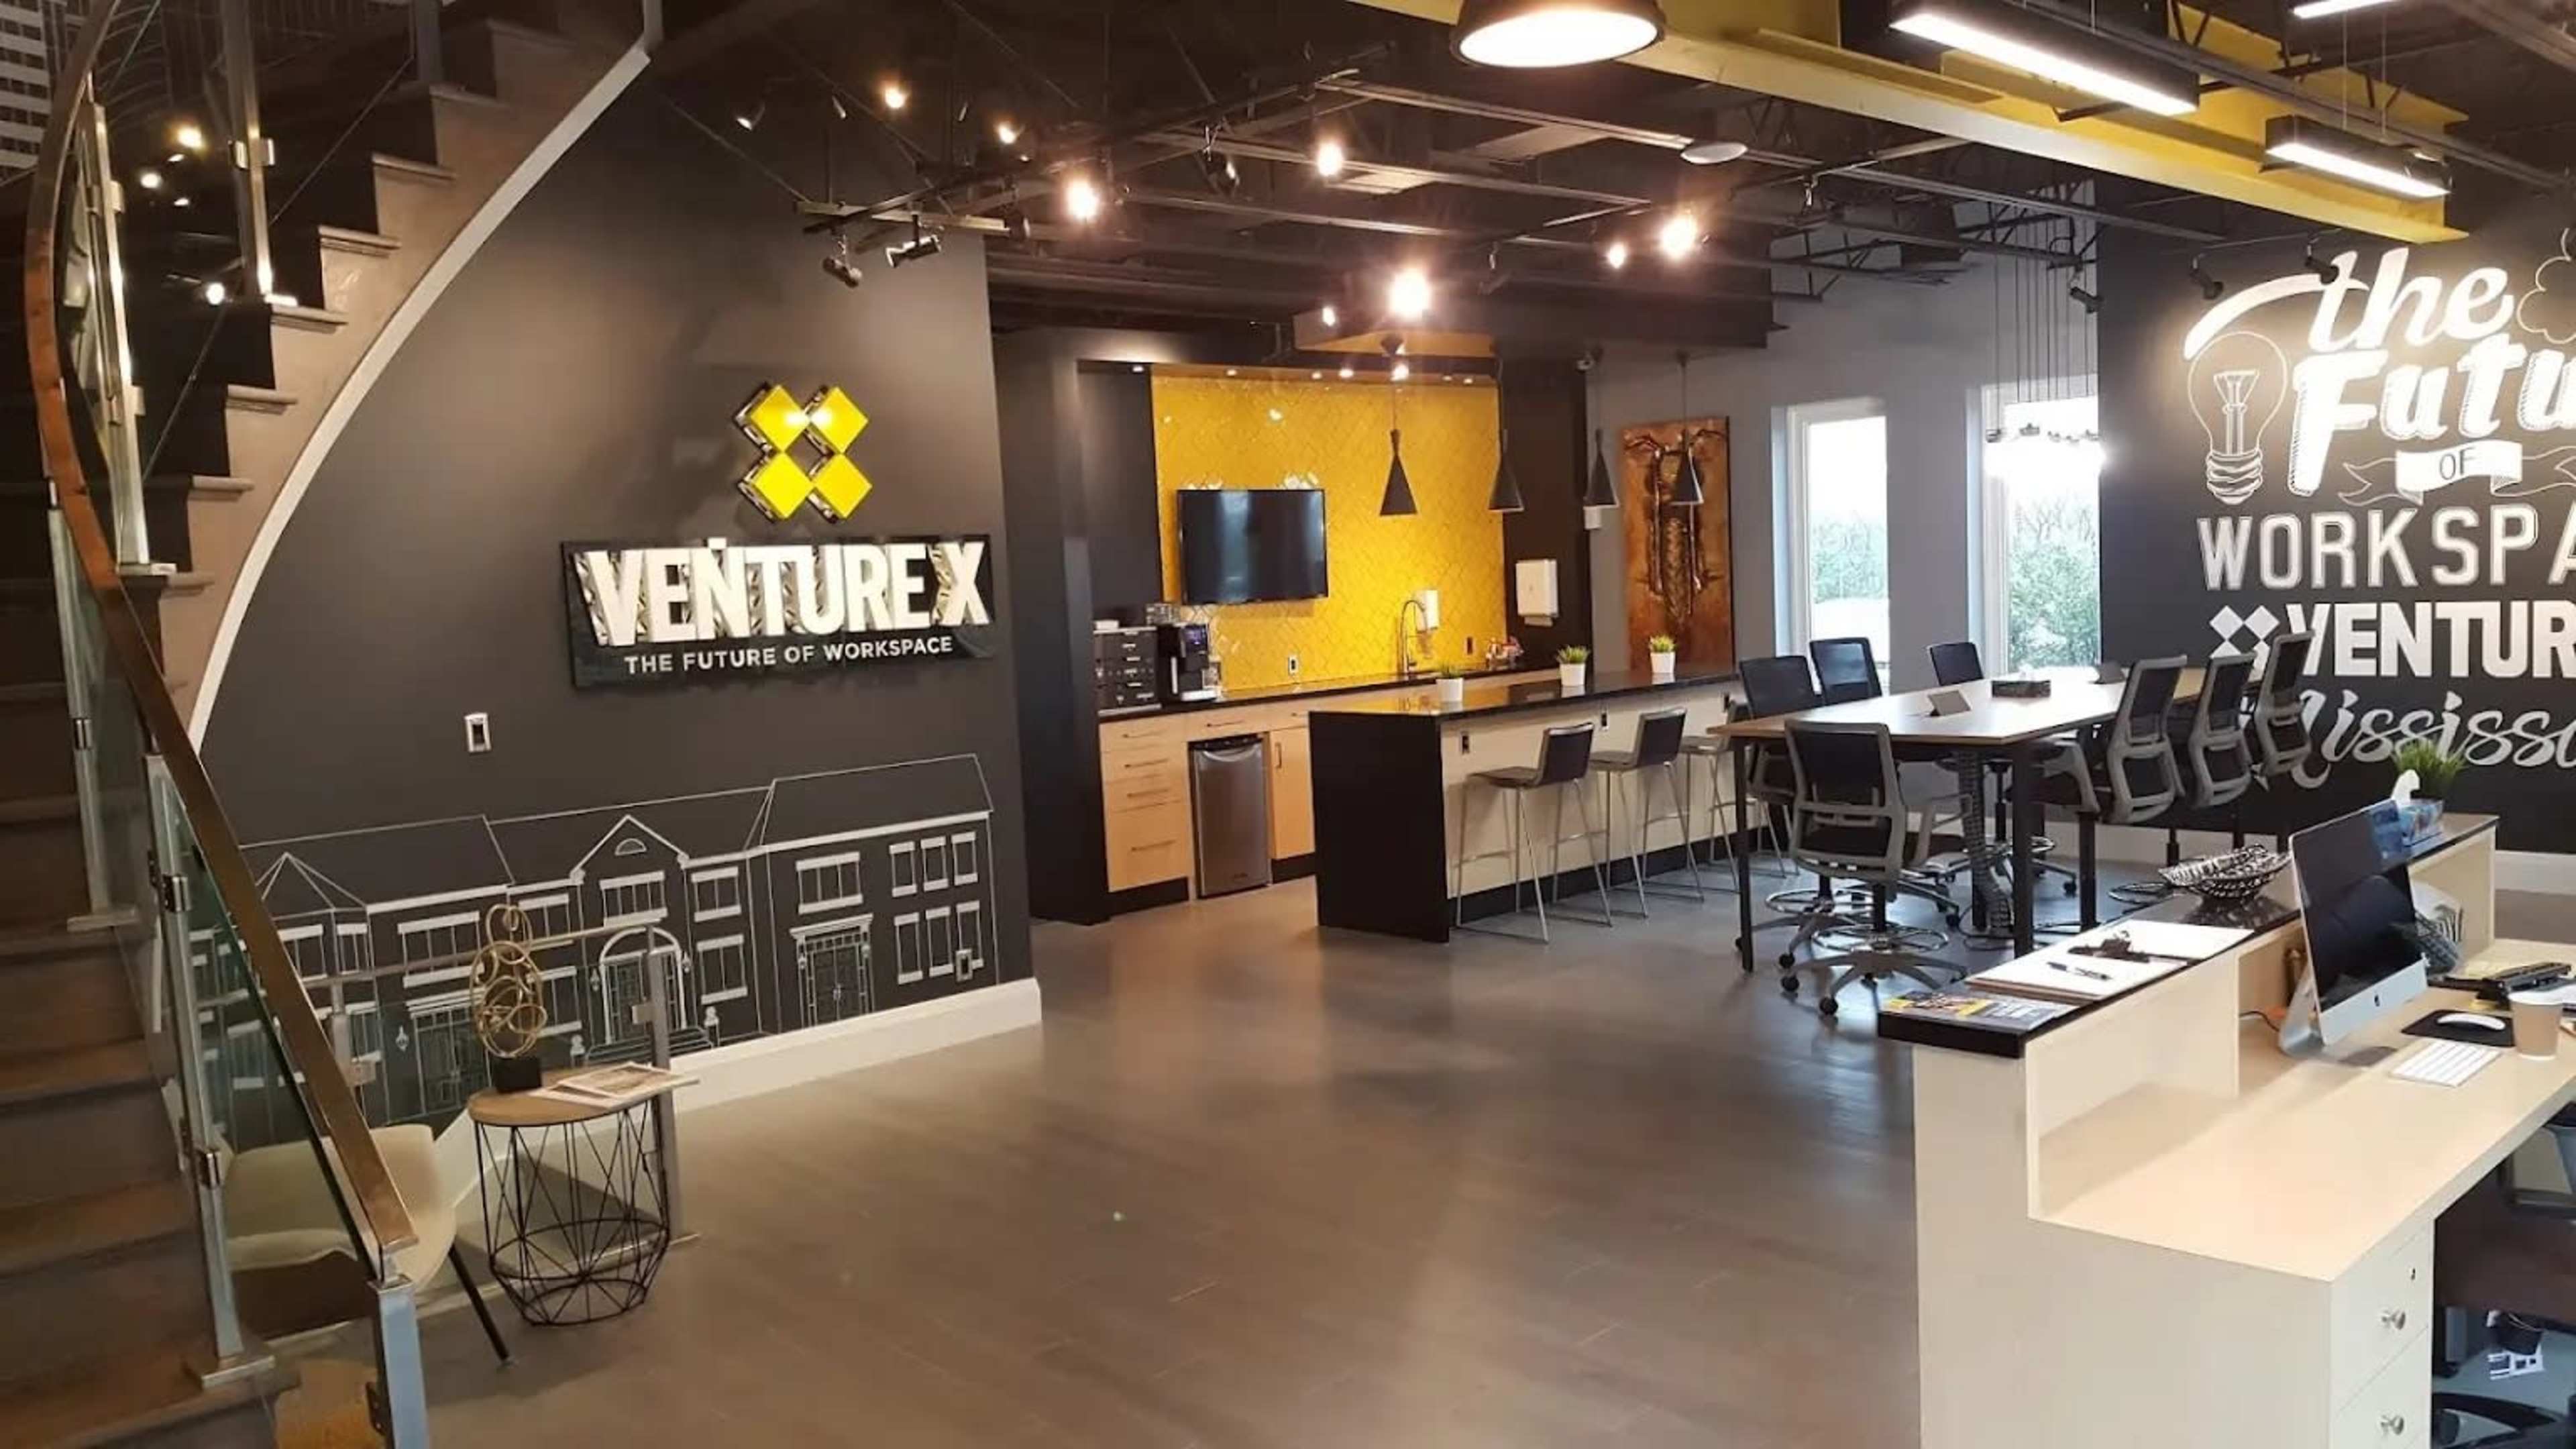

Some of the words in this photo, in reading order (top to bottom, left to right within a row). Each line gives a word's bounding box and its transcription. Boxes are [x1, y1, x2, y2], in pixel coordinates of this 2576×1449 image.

[2184, 248, 2514, 360] the
[2288, 333, 2576, 496] Futu
[2438, 447, 2478, 480] OF
[576, 543, 932, 647] VENTURE
[625, 654, 673, 674] THE
[683, 647, 776, 669] FUTURE
[784, 645, 815, 663] OF
[823, 636, 953, 661] WORKSPACE
